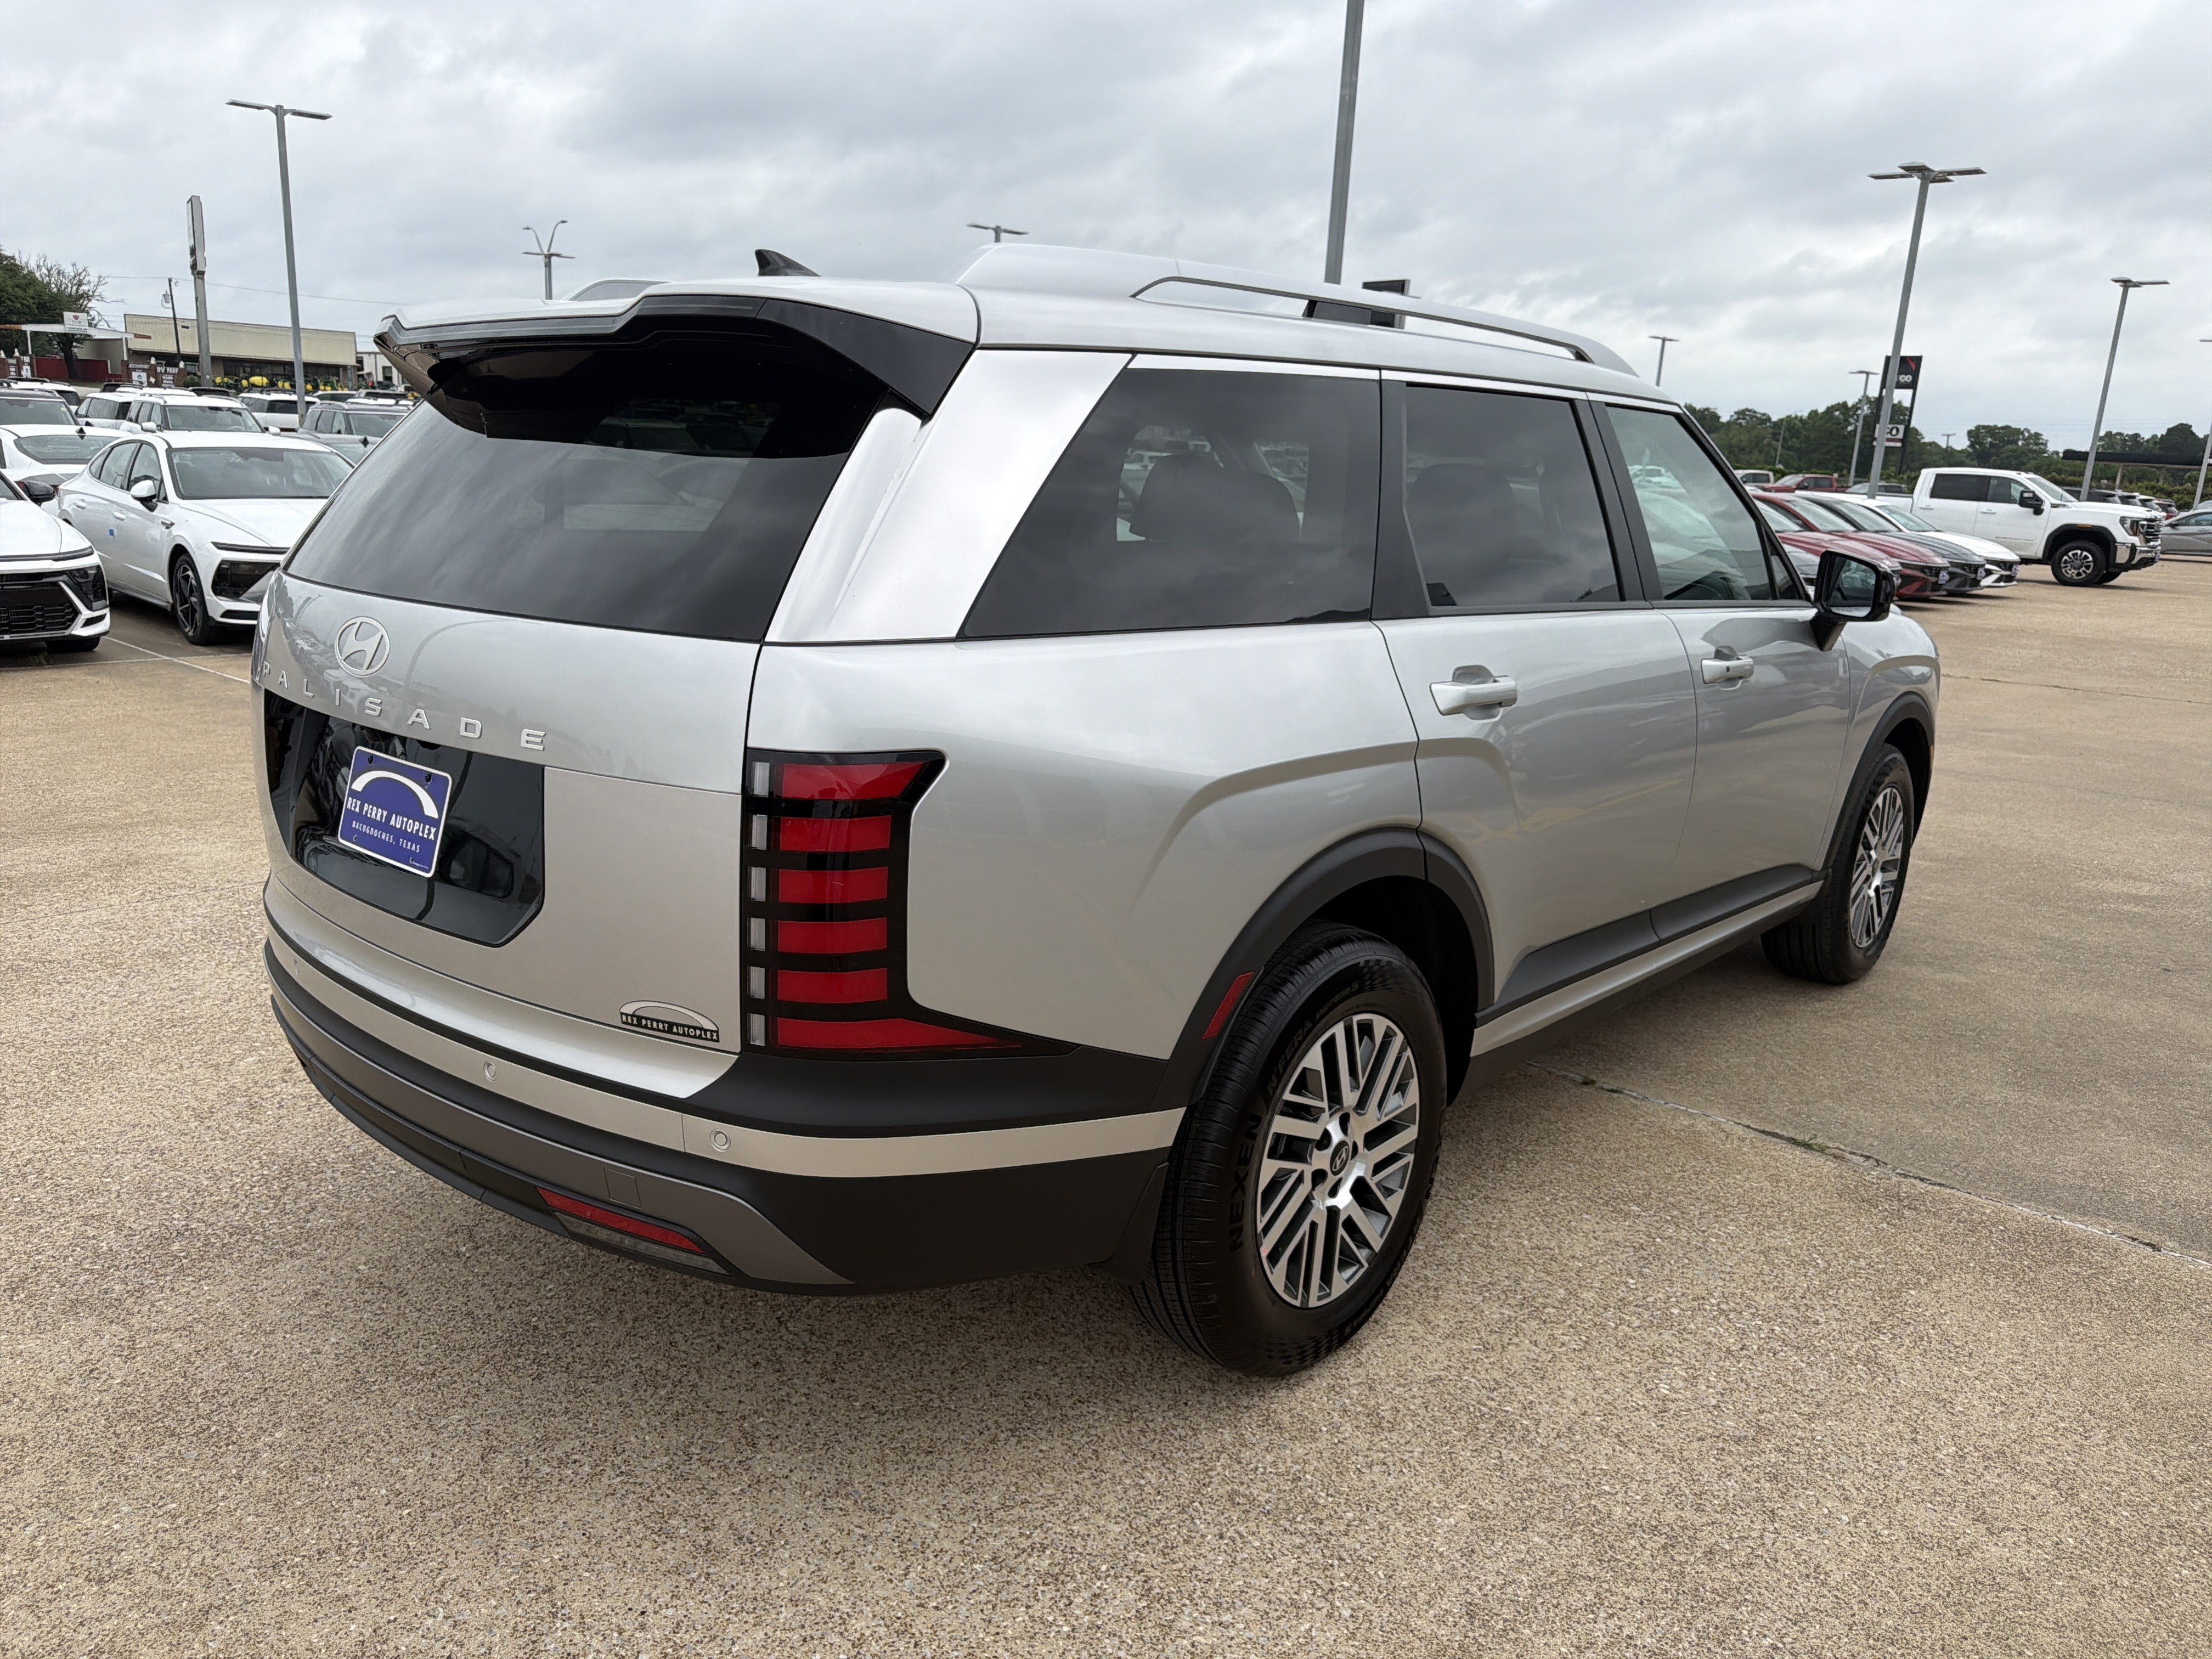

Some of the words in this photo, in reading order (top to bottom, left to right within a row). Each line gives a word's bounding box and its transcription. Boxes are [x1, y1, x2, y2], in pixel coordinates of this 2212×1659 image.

[262, 661, 546, 751] PALISADE
[347, 797, 361, 813] REX
[363, 803, 388, 823] PERRY
[390, 814, 436, 840] AUTOPLEX
[352, 821, 396, 845] NACOGDOCHES,
[400, 839, 420, 853] TEXAS
[622, 1015, 638, 1025] REX
[641, 1019, 668, 1031] PERRY
[673, 1025, 718, 1040] AUTOPLEX
[1229, 1113, 1261, 1251] NEXEN
